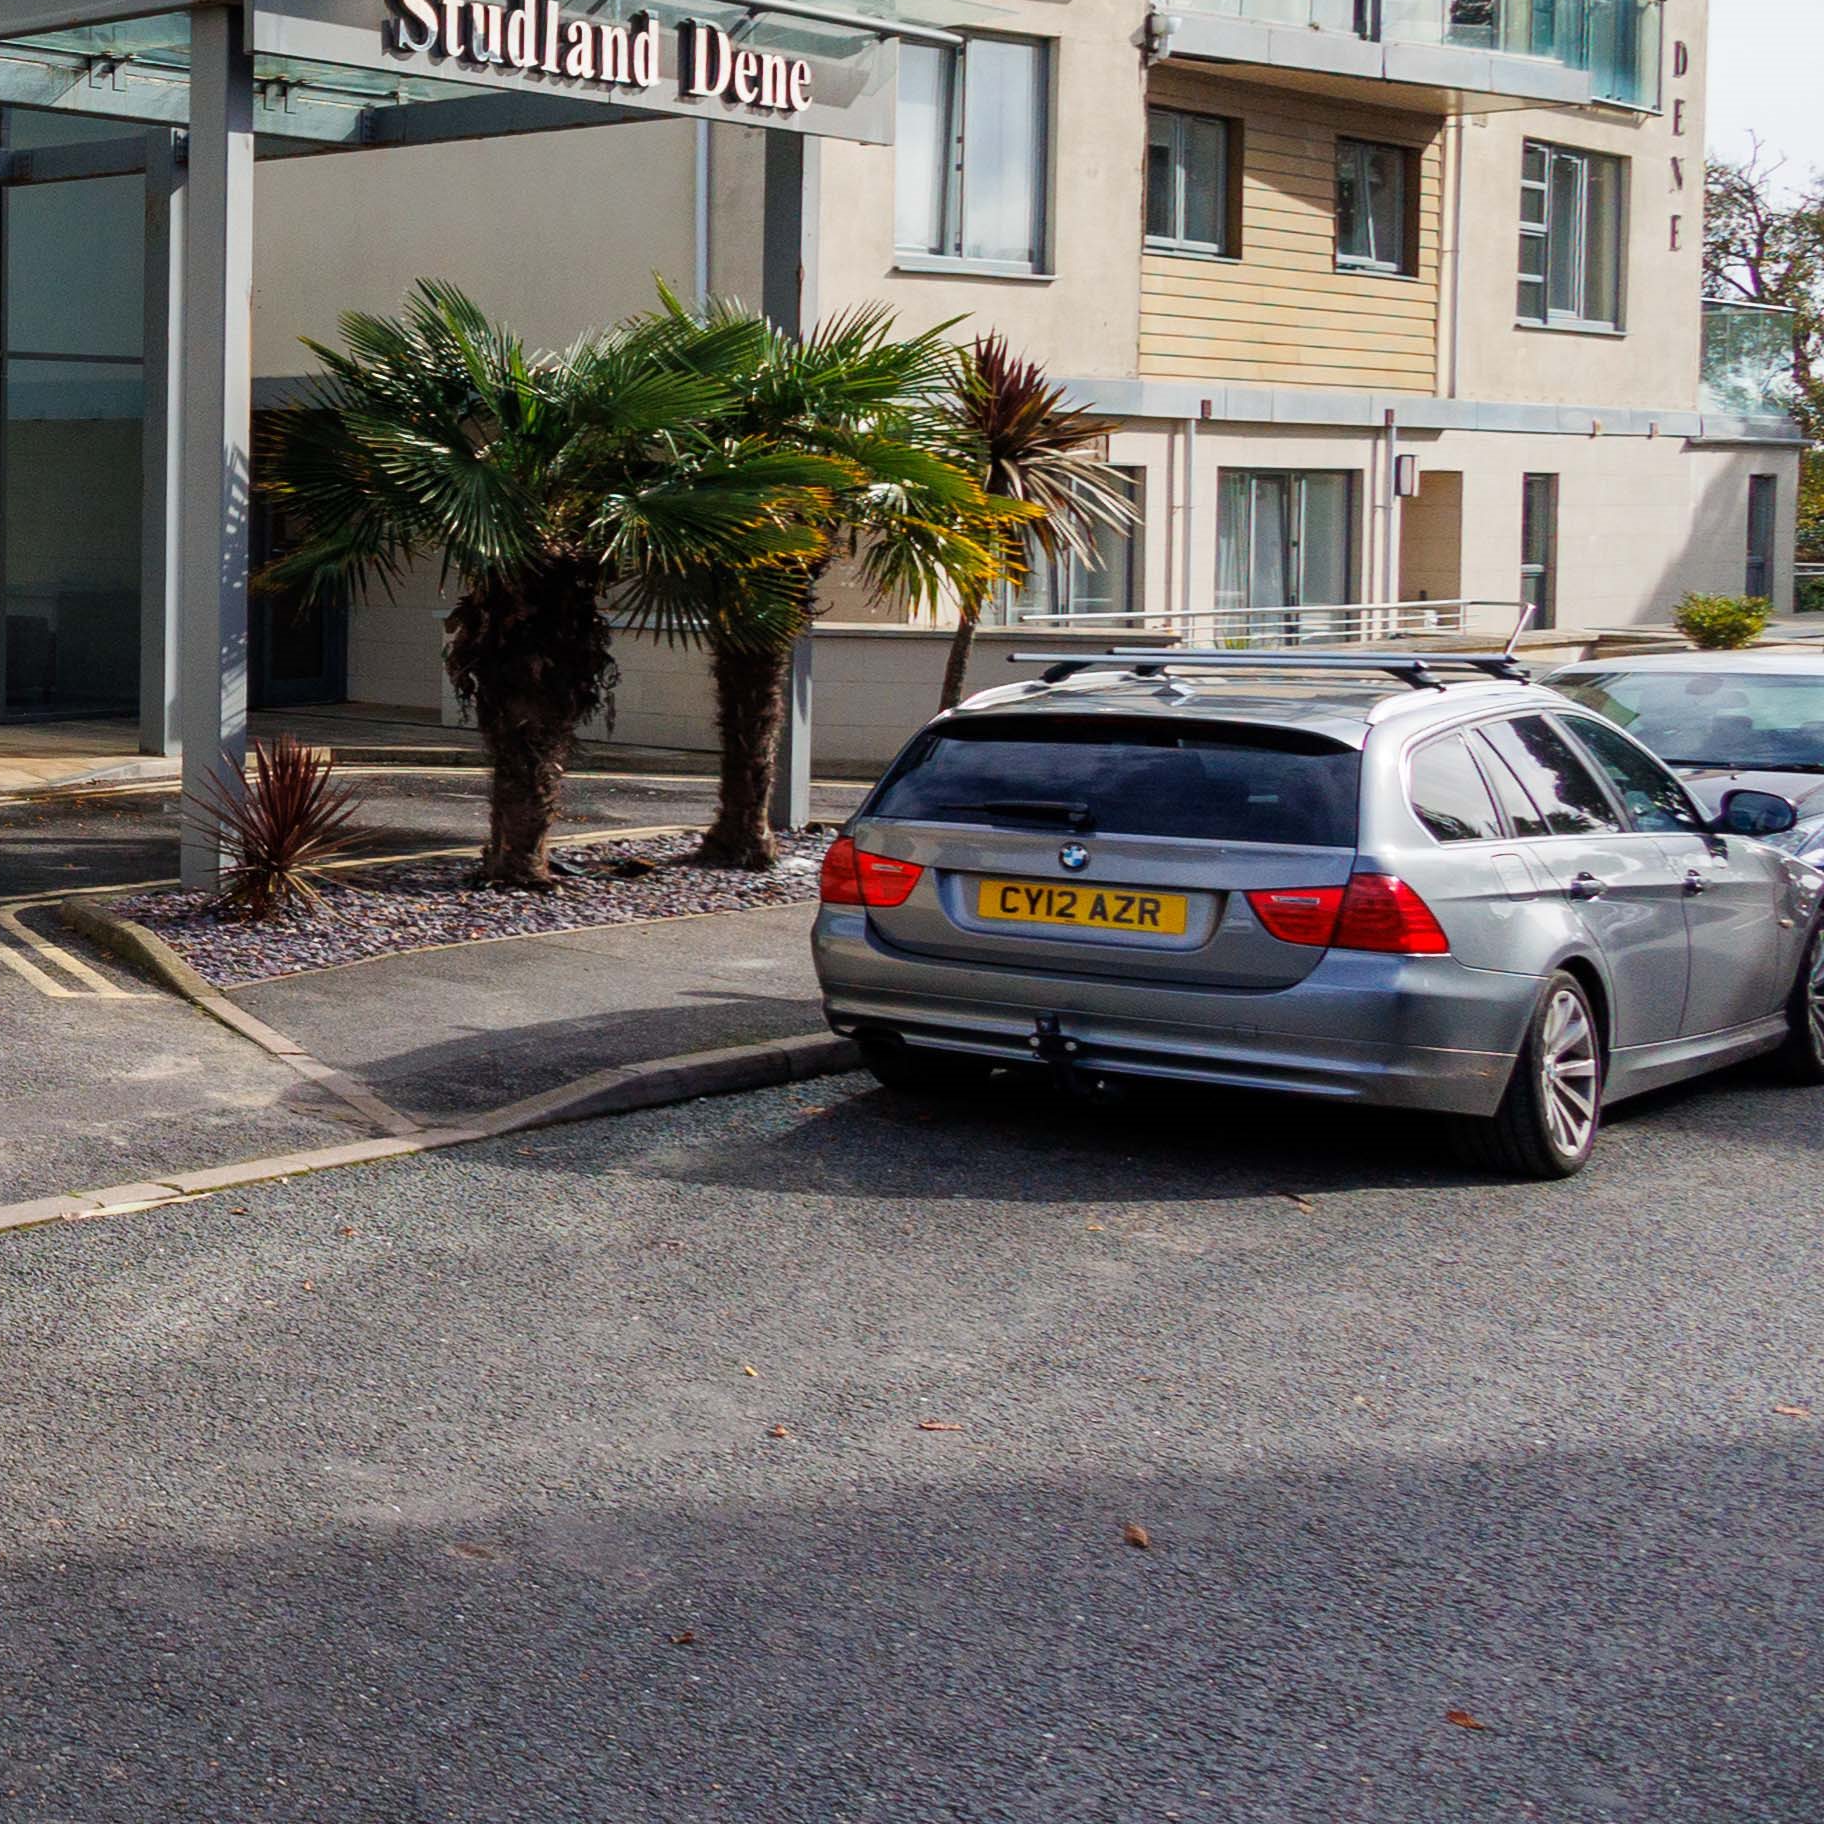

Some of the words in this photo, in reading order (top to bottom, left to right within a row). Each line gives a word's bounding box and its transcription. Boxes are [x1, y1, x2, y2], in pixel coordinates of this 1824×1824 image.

[678, 16, 814, 113] Dene
[1669, 40, 1689, 252] DENE
[1000, 886, 1077, 919] CY12
[1088, 893, 1161, 927] AZR
